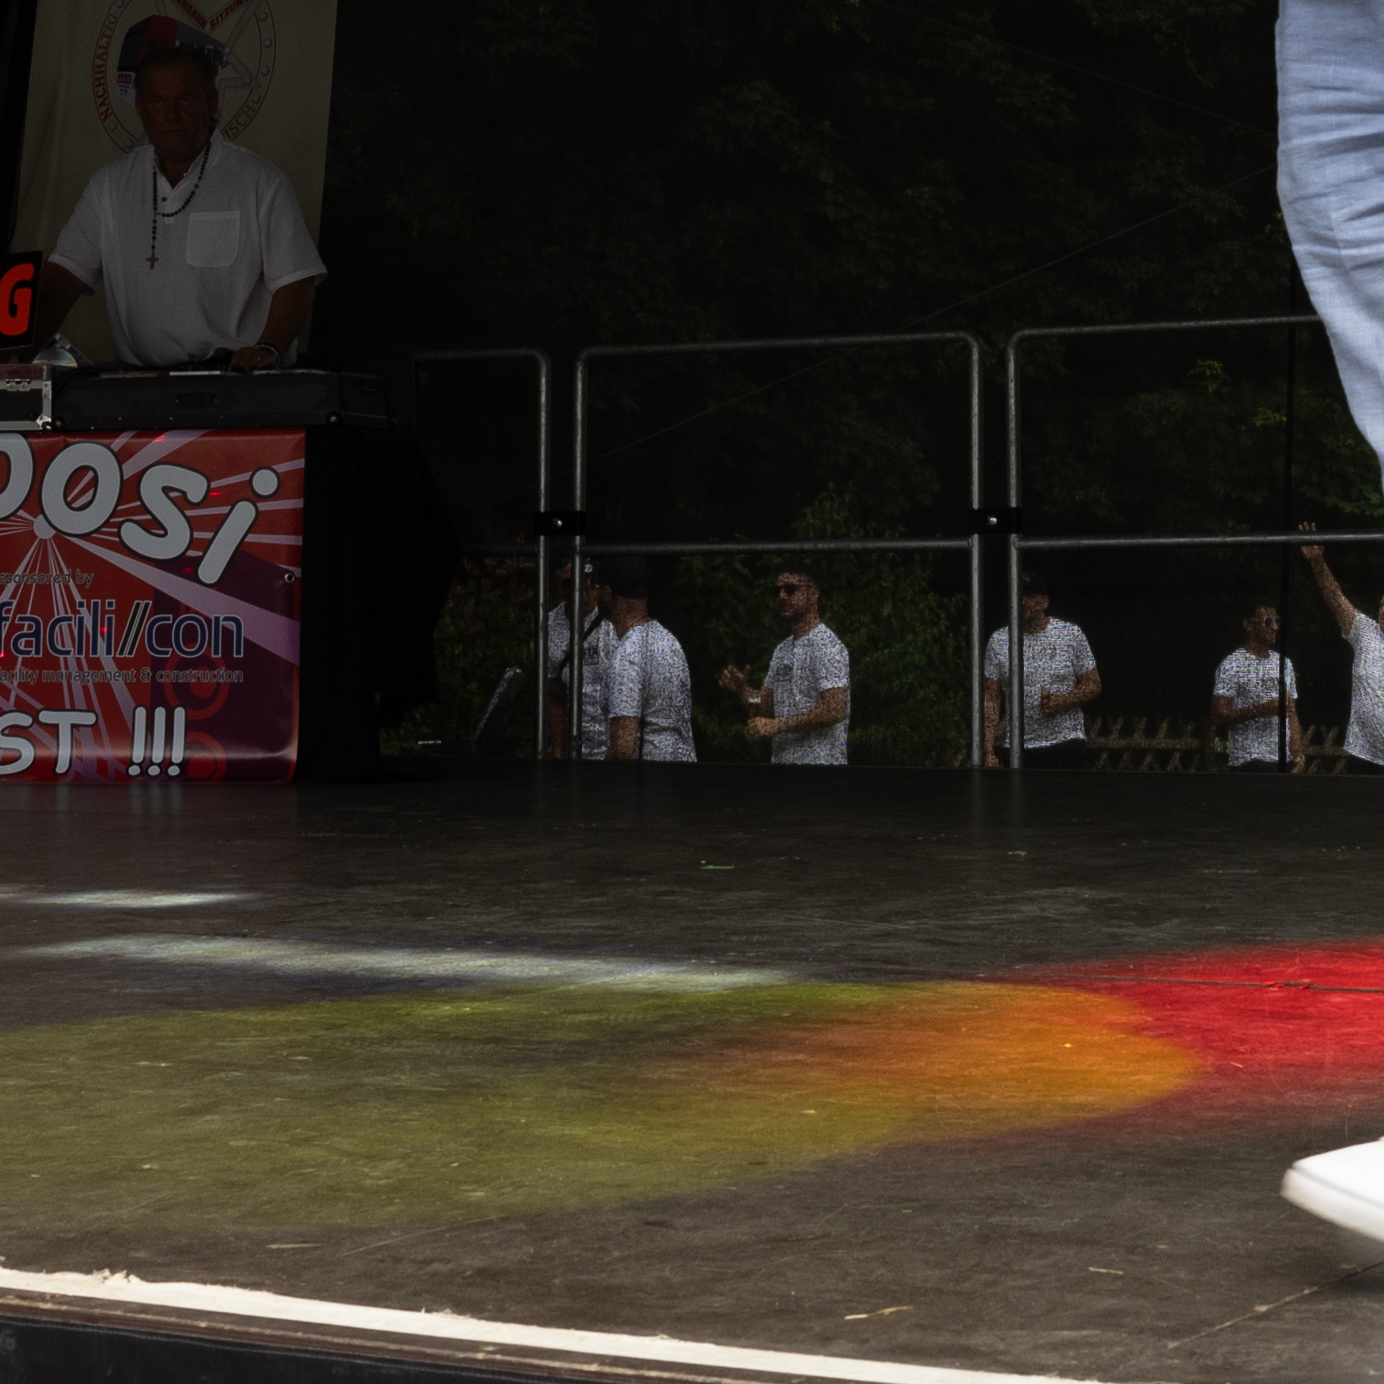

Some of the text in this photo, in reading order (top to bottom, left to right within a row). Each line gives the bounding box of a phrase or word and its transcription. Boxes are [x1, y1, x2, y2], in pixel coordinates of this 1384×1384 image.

[94, 13, 119, 122] NACHHALTIG
[75, 570, 95, 588] by
[41, 669, 135, 685] management
[139, 668, 151, 683] &
[155, 668, 244, 683] construction
[124, 704, 189, 779] !!!
